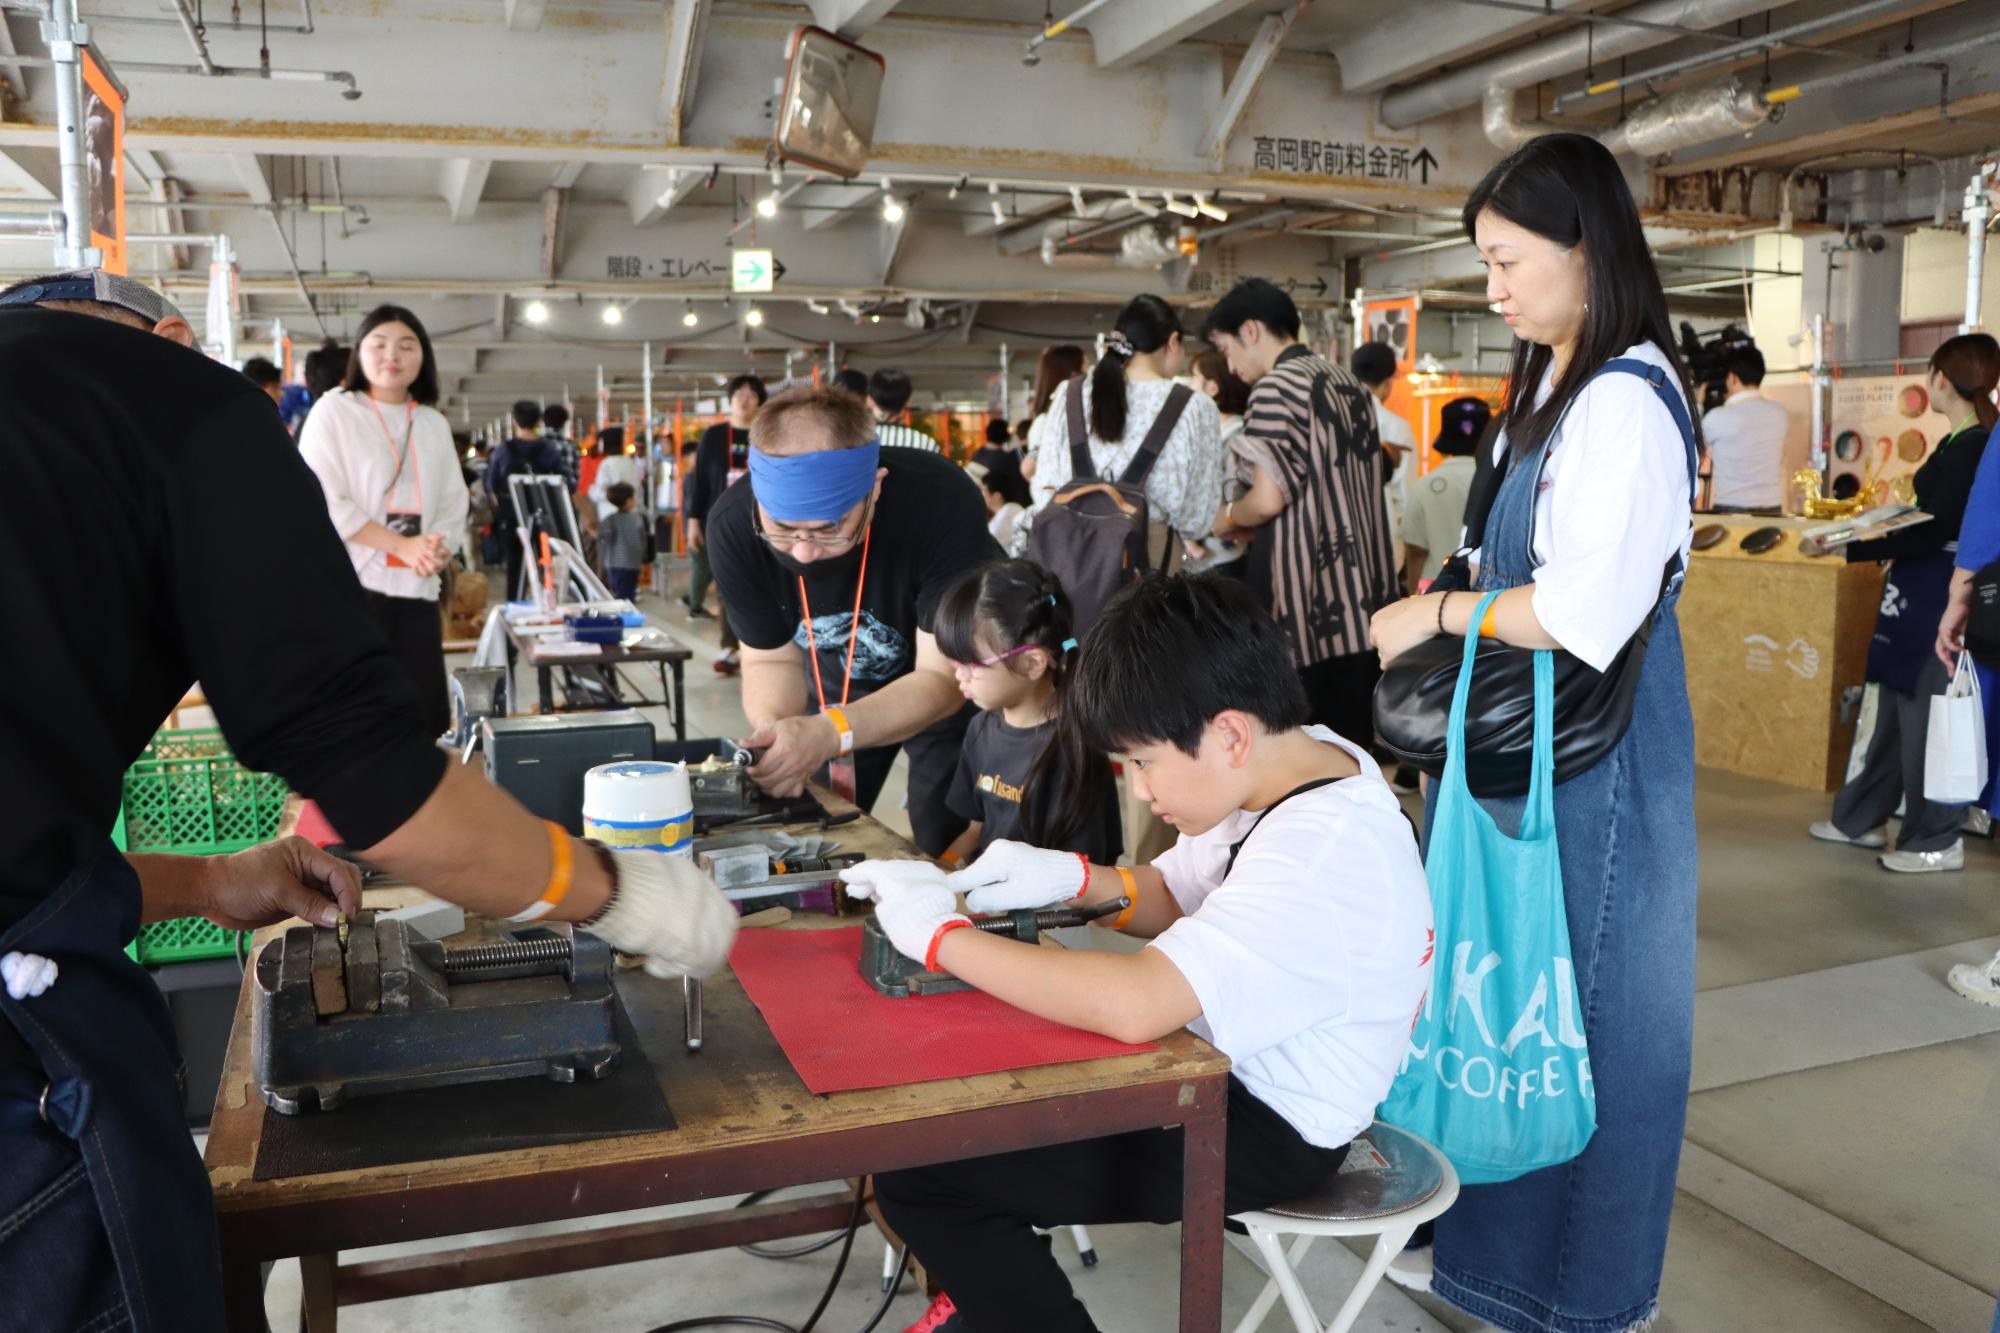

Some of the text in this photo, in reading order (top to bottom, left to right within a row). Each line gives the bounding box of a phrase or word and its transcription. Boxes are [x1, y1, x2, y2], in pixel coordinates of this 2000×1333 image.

[1253, 135, 1410, 180] 高岡駅前料金所
[607, 256, 728, 278] 階段・エレベー
[1435, 1046, 1565, 1110] COFFEE
